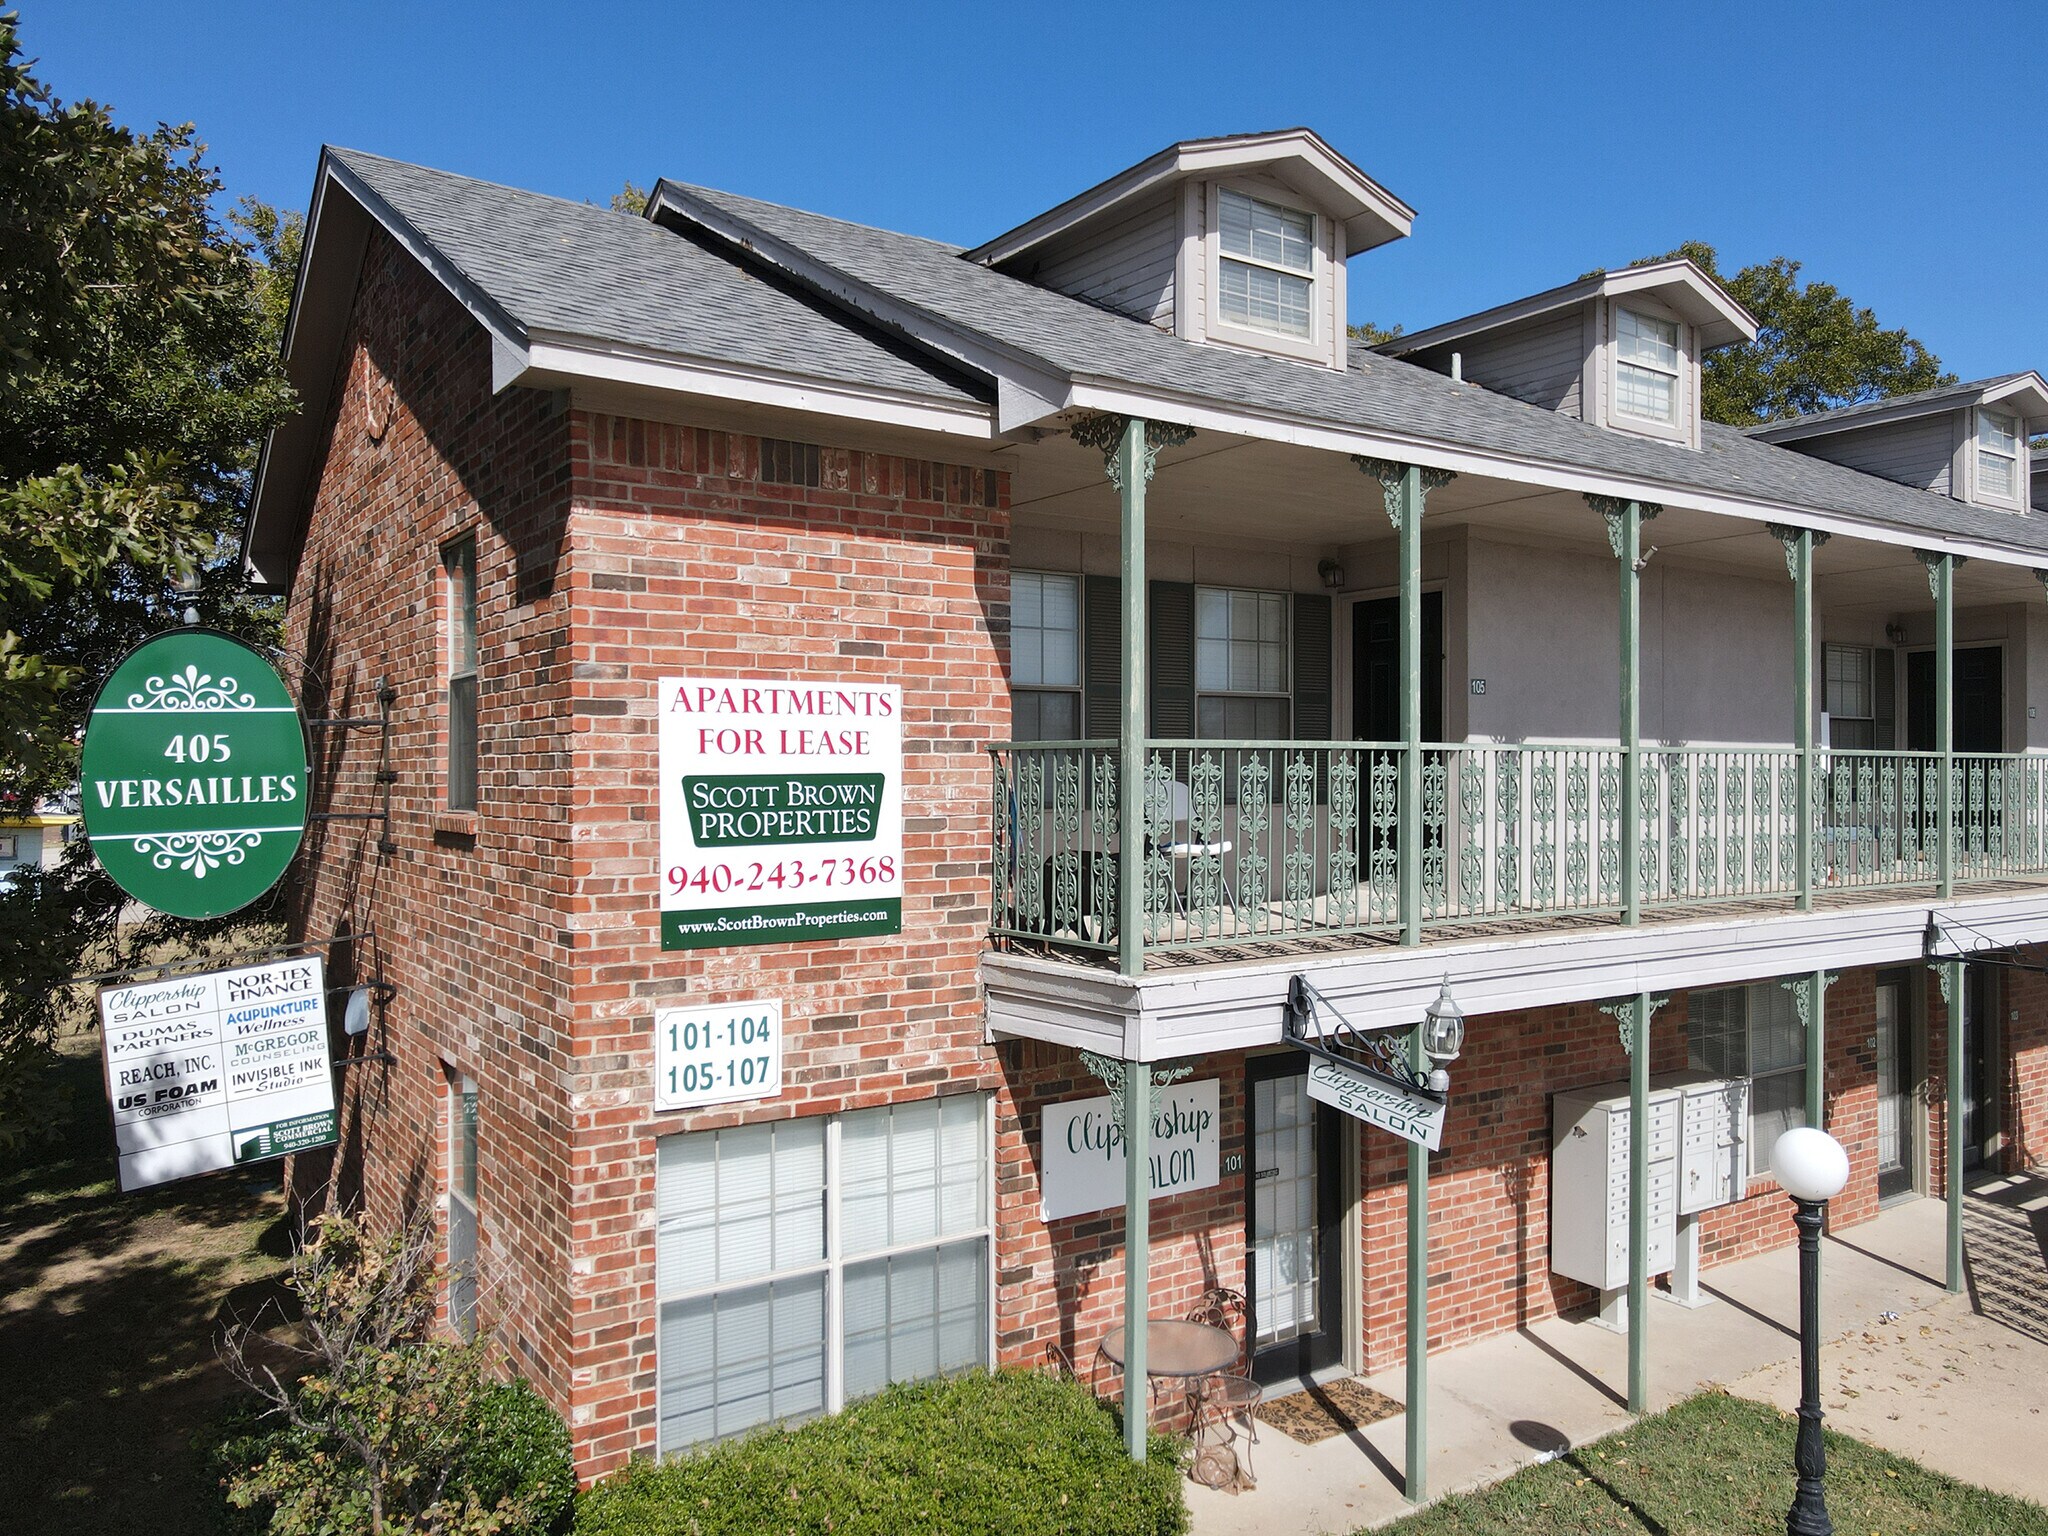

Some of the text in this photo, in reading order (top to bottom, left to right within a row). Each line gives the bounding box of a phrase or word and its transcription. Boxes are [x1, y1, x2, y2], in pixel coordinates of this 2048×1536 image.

[1472, 680, 1485, 694] 105
[670, 686, 893, 717] APARTMENTS
[164, 734, 231, 763] 405
[697, 728, 870, 756] FOR LEASE
[95, 775, 297, 808] VERSAILLES
[700, 808, 871, 839] PROPERTIES
[668, 855, 895, 896] 940-243-7368
[678, 909, 888, 934] www.ScottBrownProperties.com
[228, 966, 312, 990] NOR-TEX
[230, 978, 313, 1002] FINANCE
[109, 984, 206, 1011] Clippership
[113, 1001, 201, 1023] SALON
[226, 998, 319, 1025] ACUPUNCTURE
[122, 1021, 197, 1041] DUMAS
[238, 1016, 306, 1035] Wellness
[669, 1016, 770, 1052] 101-104
[113, 1028, 214, 1053] PARTNERS
[235, 1030, 319, 1057] McGREGOR
[230, 1042, 326, 1067] COUNSELING
[119, 1055, 216, 1087] REACH, INC.
[232, 1057, 323, 1086] INVISIBLE INK
[255, 1075, 304, 1092] Studio
[668, 1056, 770, 1094] 105-107
[118, 1078, 218, 1110] US FOAM
[1313, 1064, 1435, 1121] Clippership
[138, 1097, 202, 1117] CORPORATION
[289, 1113, 329, 1126] INFORMATION
[1338, 1095, 1427, 1140] SALON
[273, 1119, 333, 1138] SCOTT BROWN
[275, 1125, 332, 1143] COMMERCIAL
[1067, 1098, 1213, 1161] Cliprship
[1225, 1154, 1242, 1171] 101
